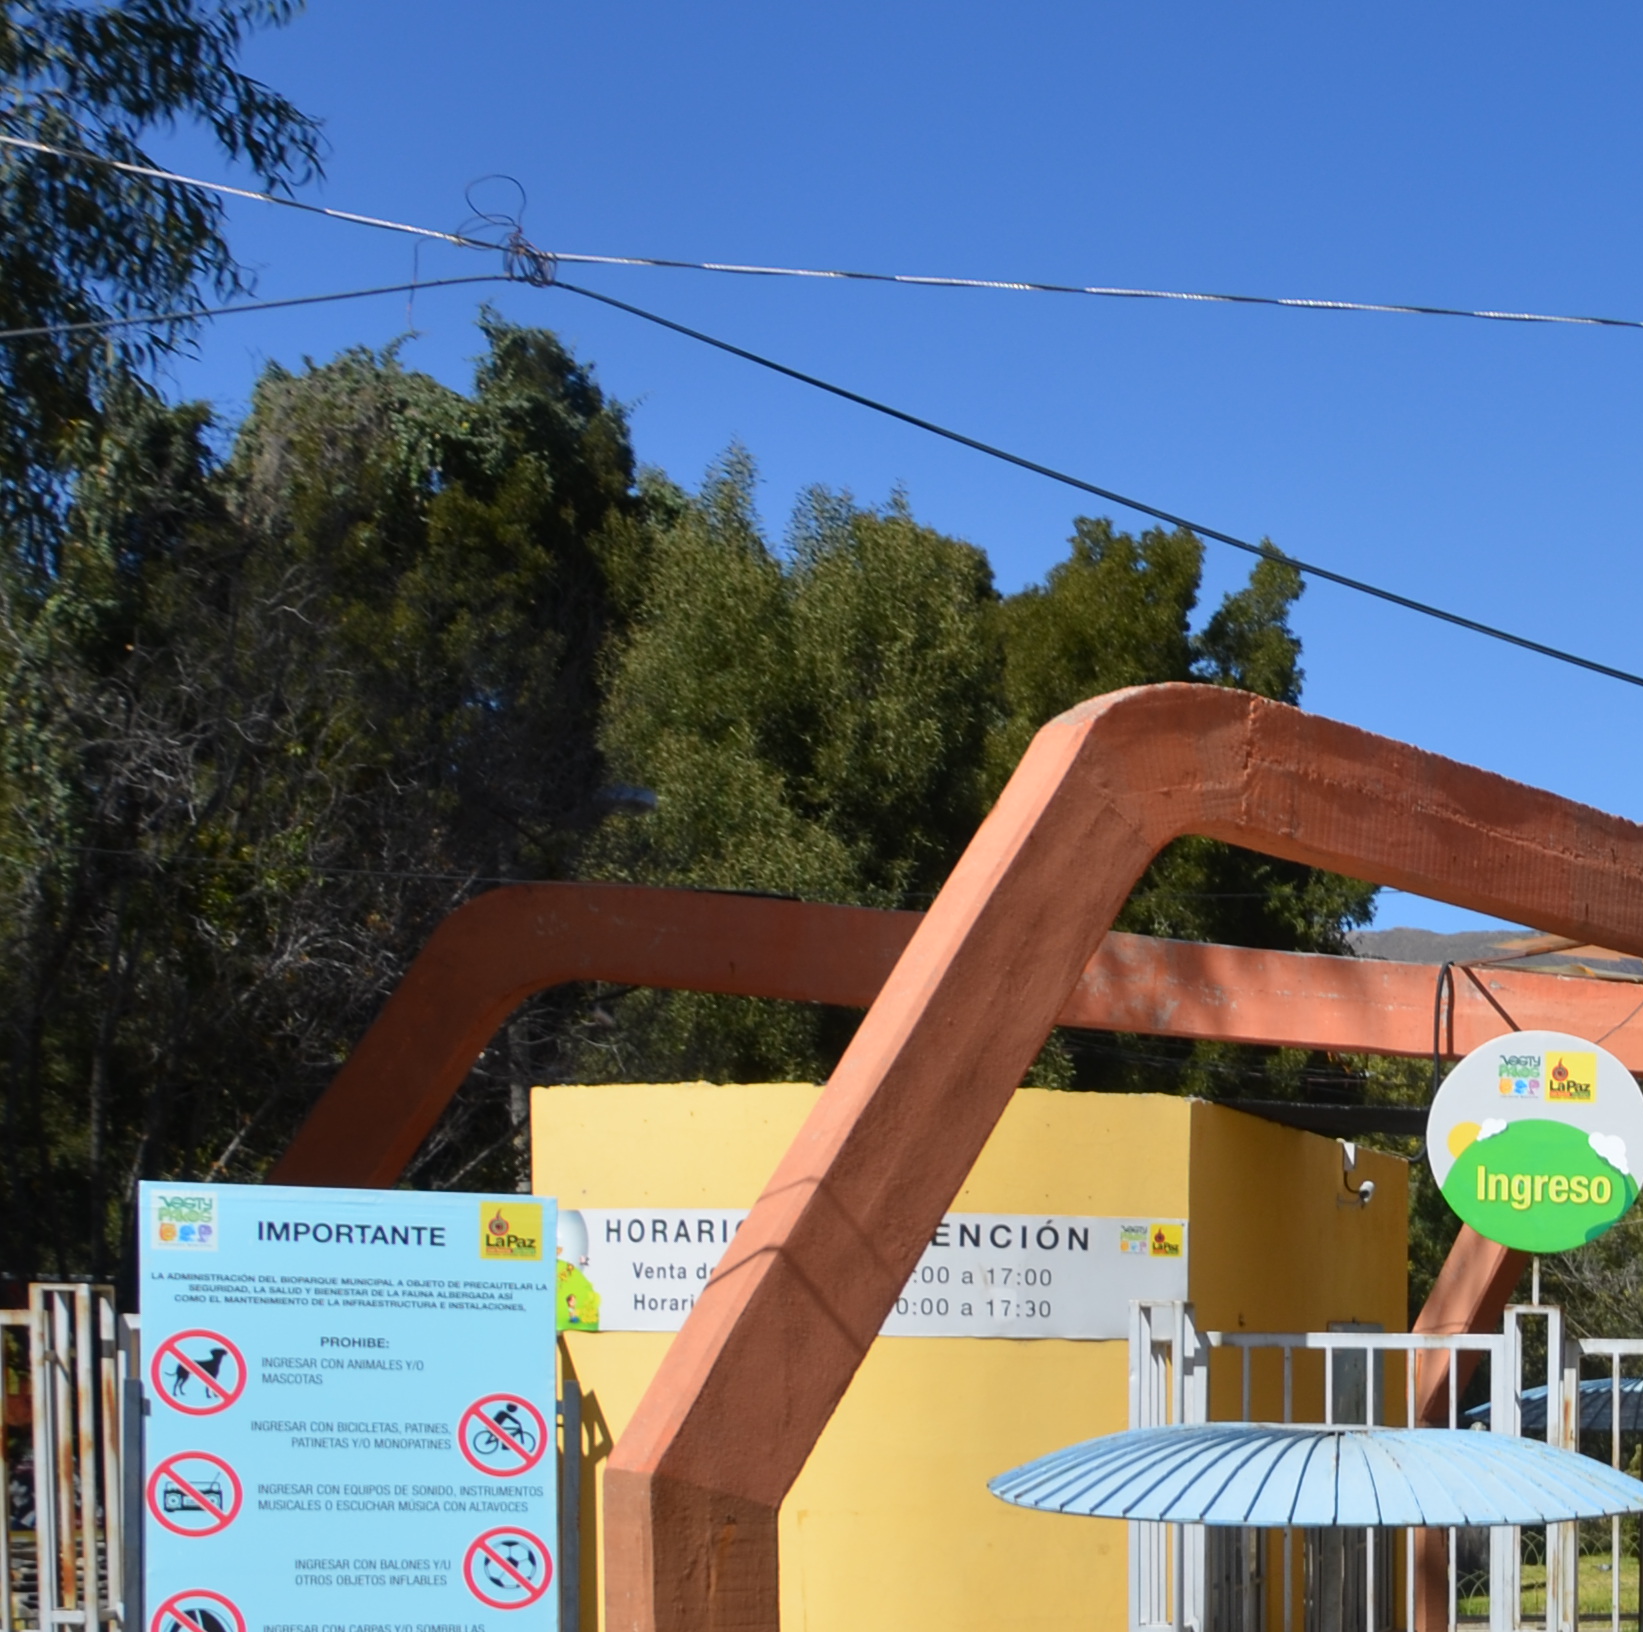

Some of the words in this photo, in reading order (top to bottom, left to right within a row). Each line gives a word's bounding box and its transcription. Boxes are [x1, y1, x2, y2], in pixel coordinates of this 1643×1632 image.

[1477, 1165, 1611, 1210] Ingreso
[258, 1221, 445, 1246] IMPORTANTE
[606, 1219, 745, 1243] HORARI
[632, 1262, 687, 1279] Venta
[961, 1270, 974, 1284] a
[987, 1267, 1052, 1286] 17:00
[634, 1294, 694, 1311] Horari
[896, 1298, 949, 1316] 0:00
[961, 1302, 973, 1316] a
[986, 1299, 1051, 1318] 17:30
[320, 1336, 389, 1348] PROHIBE:
[261, 1356, 317, 1369] INGRESAR
[320, 1358, 344, 1369] CON
[347, 1359, 403, 1371] ANIMALES
[261, 1372, 323, 1385] MASCOTAS
[250, 1420, 307, 1432] INGRESAR
[309, 1421, 334, 1433] CON
[291, 1436, 349, 1449] PATINETAS
[373, 1438, 452, 1450] MONOPATINES
[257, 1483, 313, 1495] INGRESAR
[316, 1484, 340, 1495] CON
[343, 1484, 391, 1496] EQUIPOS
[394, 1484, 408, 1496] DE
[459, 1485, 544, 1497] INSTRUMENTOS
[257, 1499, 321, 1511] MUSICALES
[336, 1500, 395, 1512] ESCUCHAR
[443, 1500, 466, 1512] CON
[469, 1501, 528, 1513] ALTAVOCES
[294, 1558, 350, 1570] INGRESAR
[353, 1559, 377, 1571] CON
[379, 1559, 430, 1571] BALONES
[294, 1574, 332, 1586] OTROS
[336, 1574, 386, 1586] OBJETOS
[389, 1574, 447, 1586] INFLABLES
